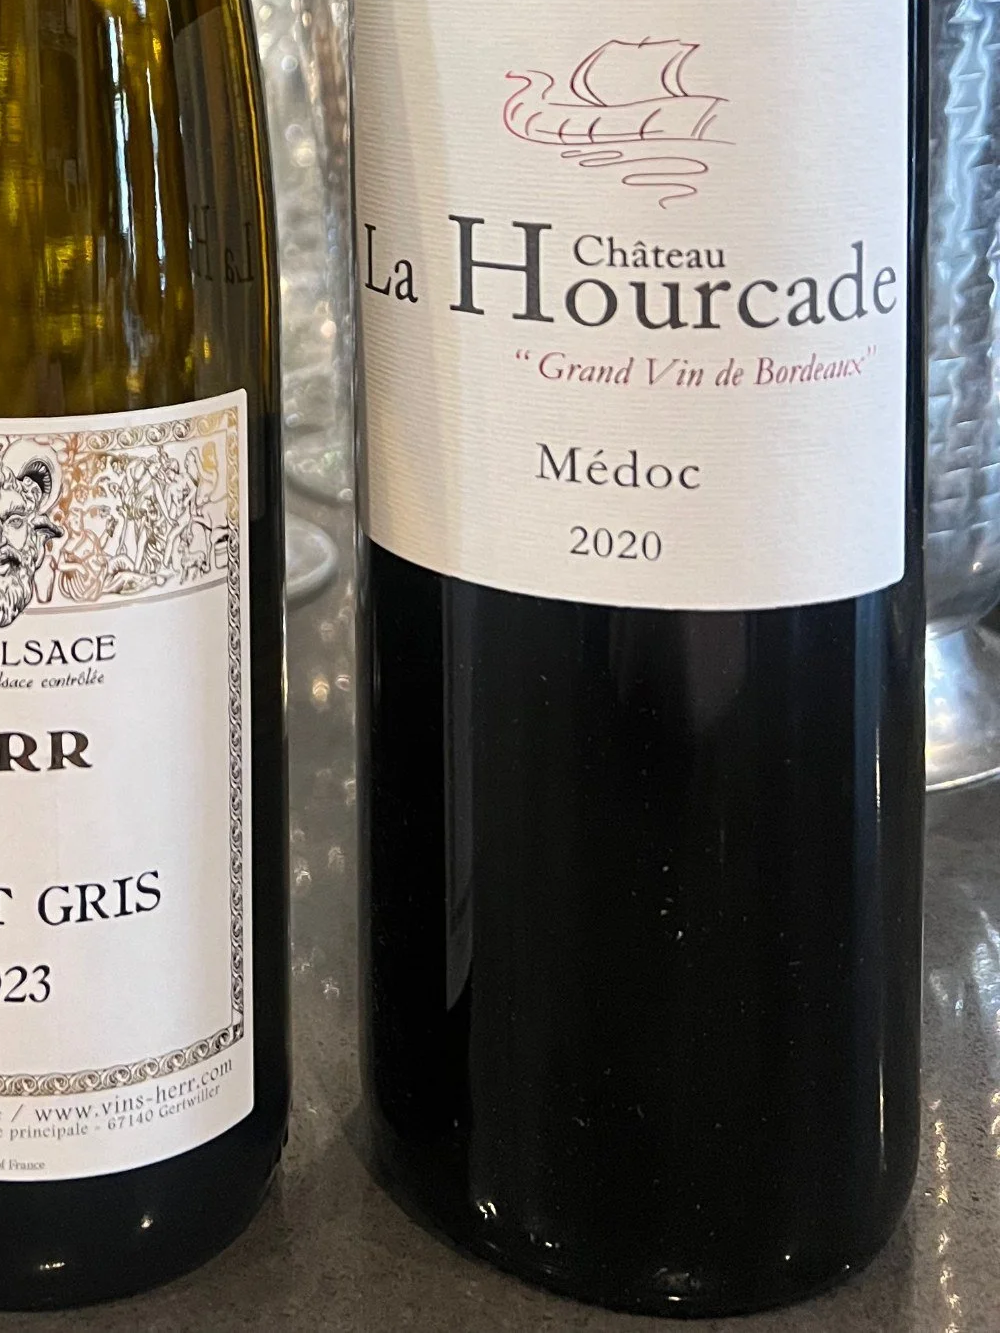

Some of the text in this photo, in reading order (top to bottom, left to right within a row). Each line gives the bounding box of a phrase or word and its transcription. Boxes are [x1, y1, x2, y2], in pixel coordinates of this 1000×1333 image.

[363, 213, 898, 330] La Hourcade
[573, 234, 726, 269] Château
[646, 356, 703, 387] Vin
[714, 366, 743, 387] de
[535, 442, 701, 491] Médoc
[569, 525, 663, 562] 2020
[41, 667, 105, 688] contrôlée
[37, 870, 162, 926] GRIS
[11, 1103, 24, 1123] /
[35, 1057, 233, 1122] www.vins-herr.com
[10, 1122, 89, 1141] principale
[107, 1109, 155, 1131] 67140
[158, 1083, 221, 1118] Gertwiller
[8, 1159, 45, 1170] France
